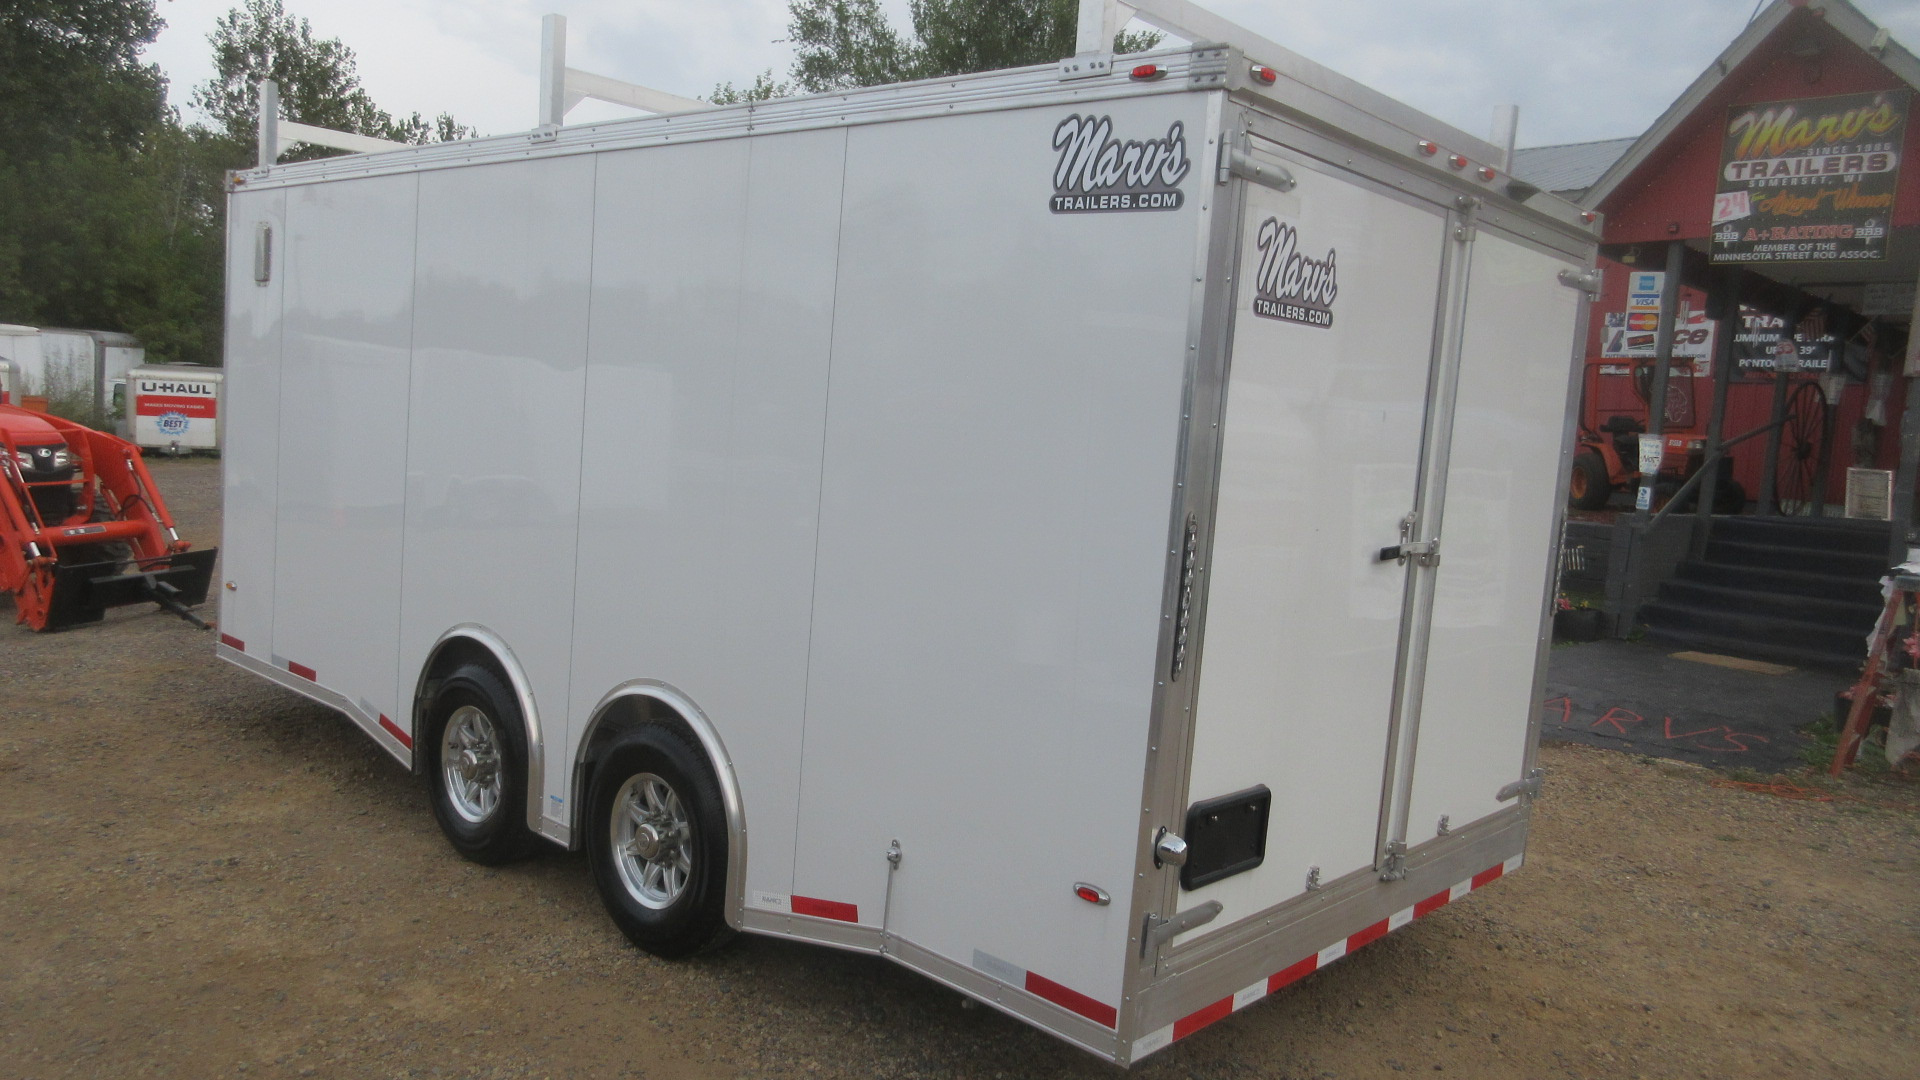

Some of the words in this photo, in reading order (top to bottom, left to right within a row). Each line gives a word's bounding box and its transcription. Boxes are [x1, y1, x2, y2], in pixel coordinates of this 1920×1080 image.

[1729, 95, 1899, 159] Marv's
[1053, 114, 1190, 193] Marv's
[1806, 145, 1847, 156] SINCE
[1731, 153, 1888, 179] TRAILERS
[1055, 193, 1177, 210] TRAILERS.COM
[1753, 244, 1797, 252] MEMBER
[1799, 243, 1813, 251] OF
[1815, 242, 1836, 250] THE
[1258, 217, 1337, 307] Marv's
[1713, 252, 1772, 261] MINNESOTA
[1775, 252, 1809, 260] STREET
[1813, 251, 1837, 259] ROD
[1636, 298, 1654, 306] VISA
[1256, 300, 1331, 325] TRAILERS.COM
[163, 419, 183, 428] BEST
